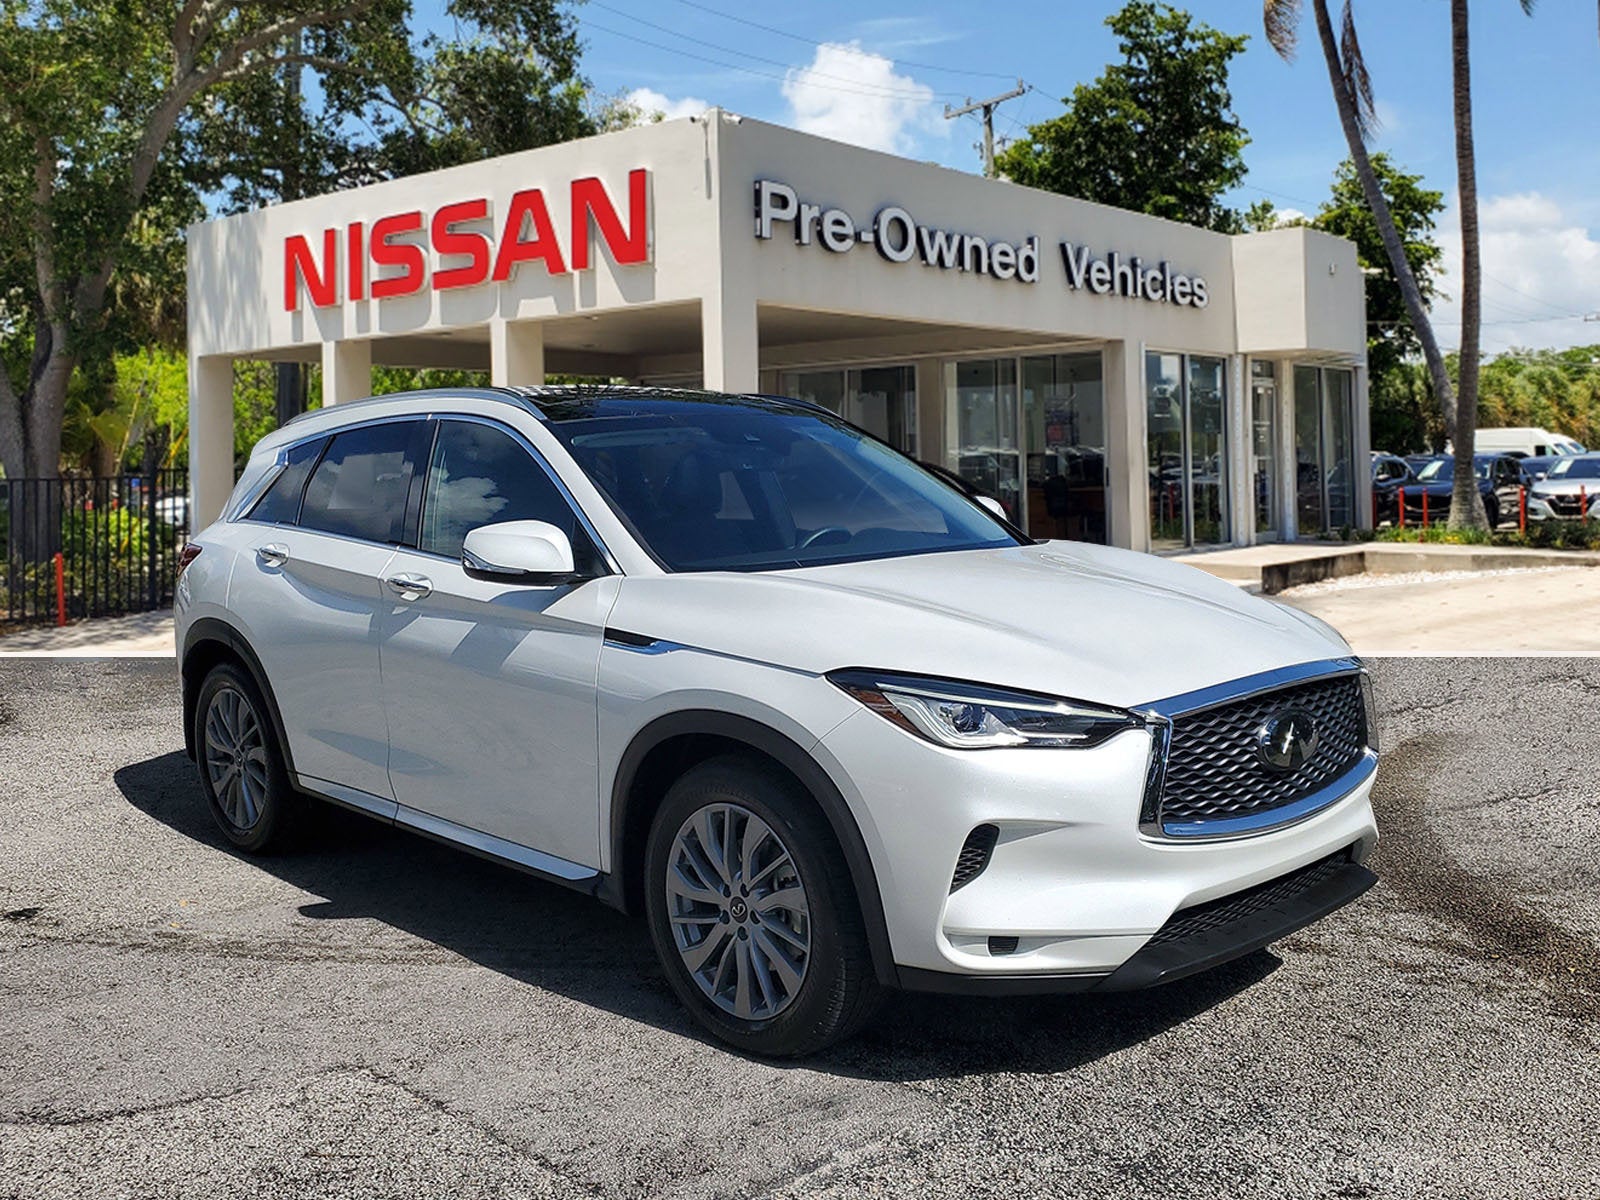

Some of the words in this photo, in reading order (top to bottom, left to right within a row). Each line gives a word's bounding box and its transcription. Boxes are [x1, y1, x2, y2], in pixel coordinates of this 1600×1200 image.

[285, 168, 647, 312] NISSAN
[755, 180, 1039, 282] Pre-Owned
[1061, 240, 1208, 308] Vehicles
